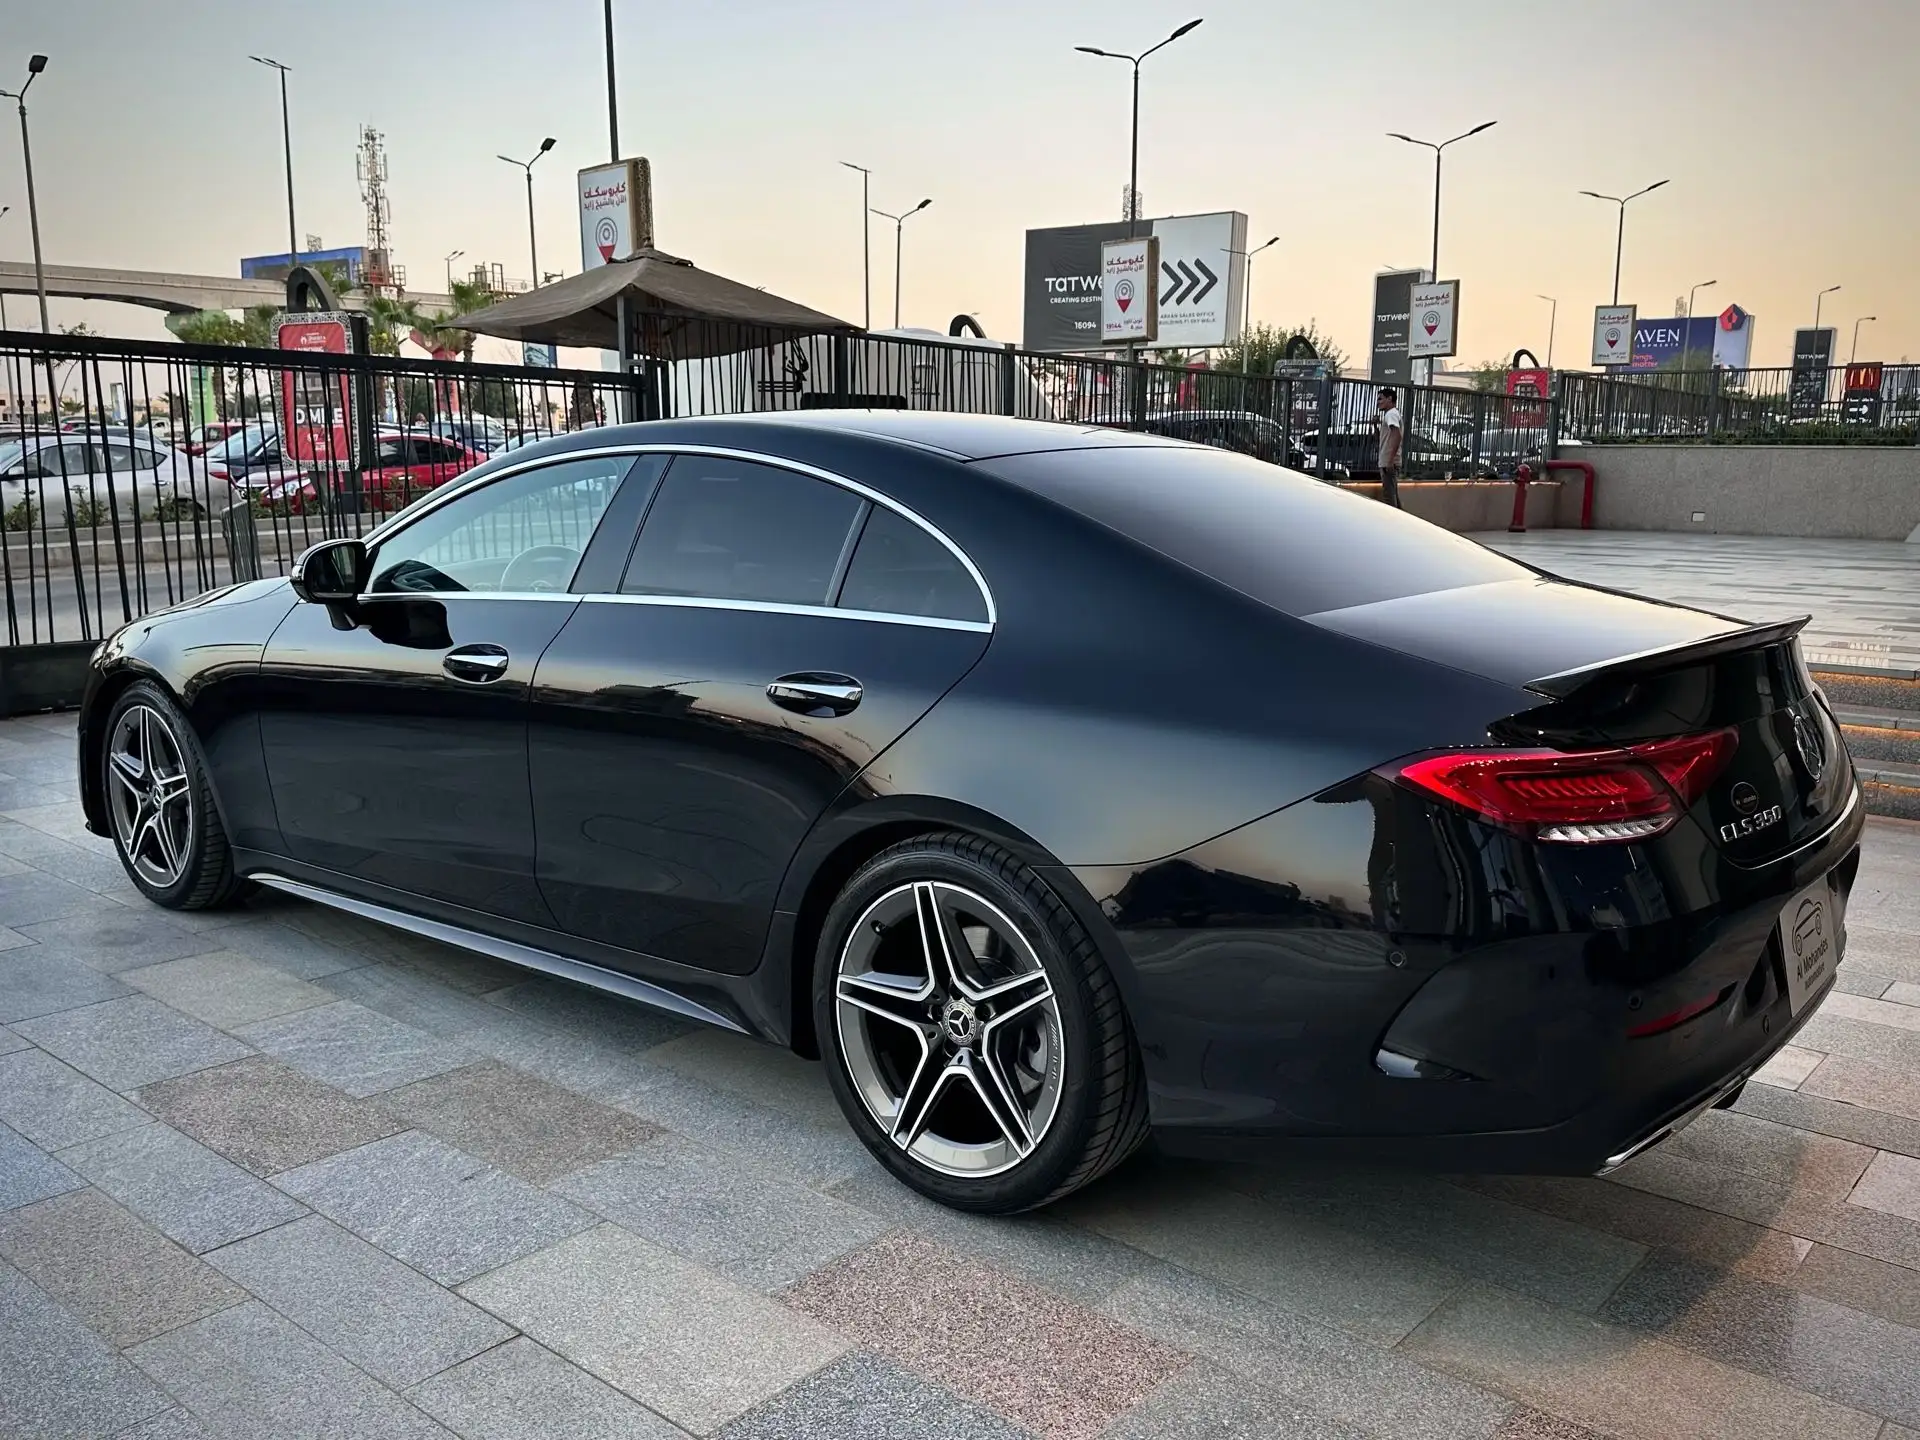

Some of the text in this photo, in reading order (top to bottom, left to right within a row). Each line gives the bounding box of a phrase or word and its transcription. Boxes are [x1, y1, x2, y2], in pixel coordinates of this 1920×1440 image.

[1074, 321, 1097, 330] 16094
[1720, 805, 1782, 842] CLS 350
